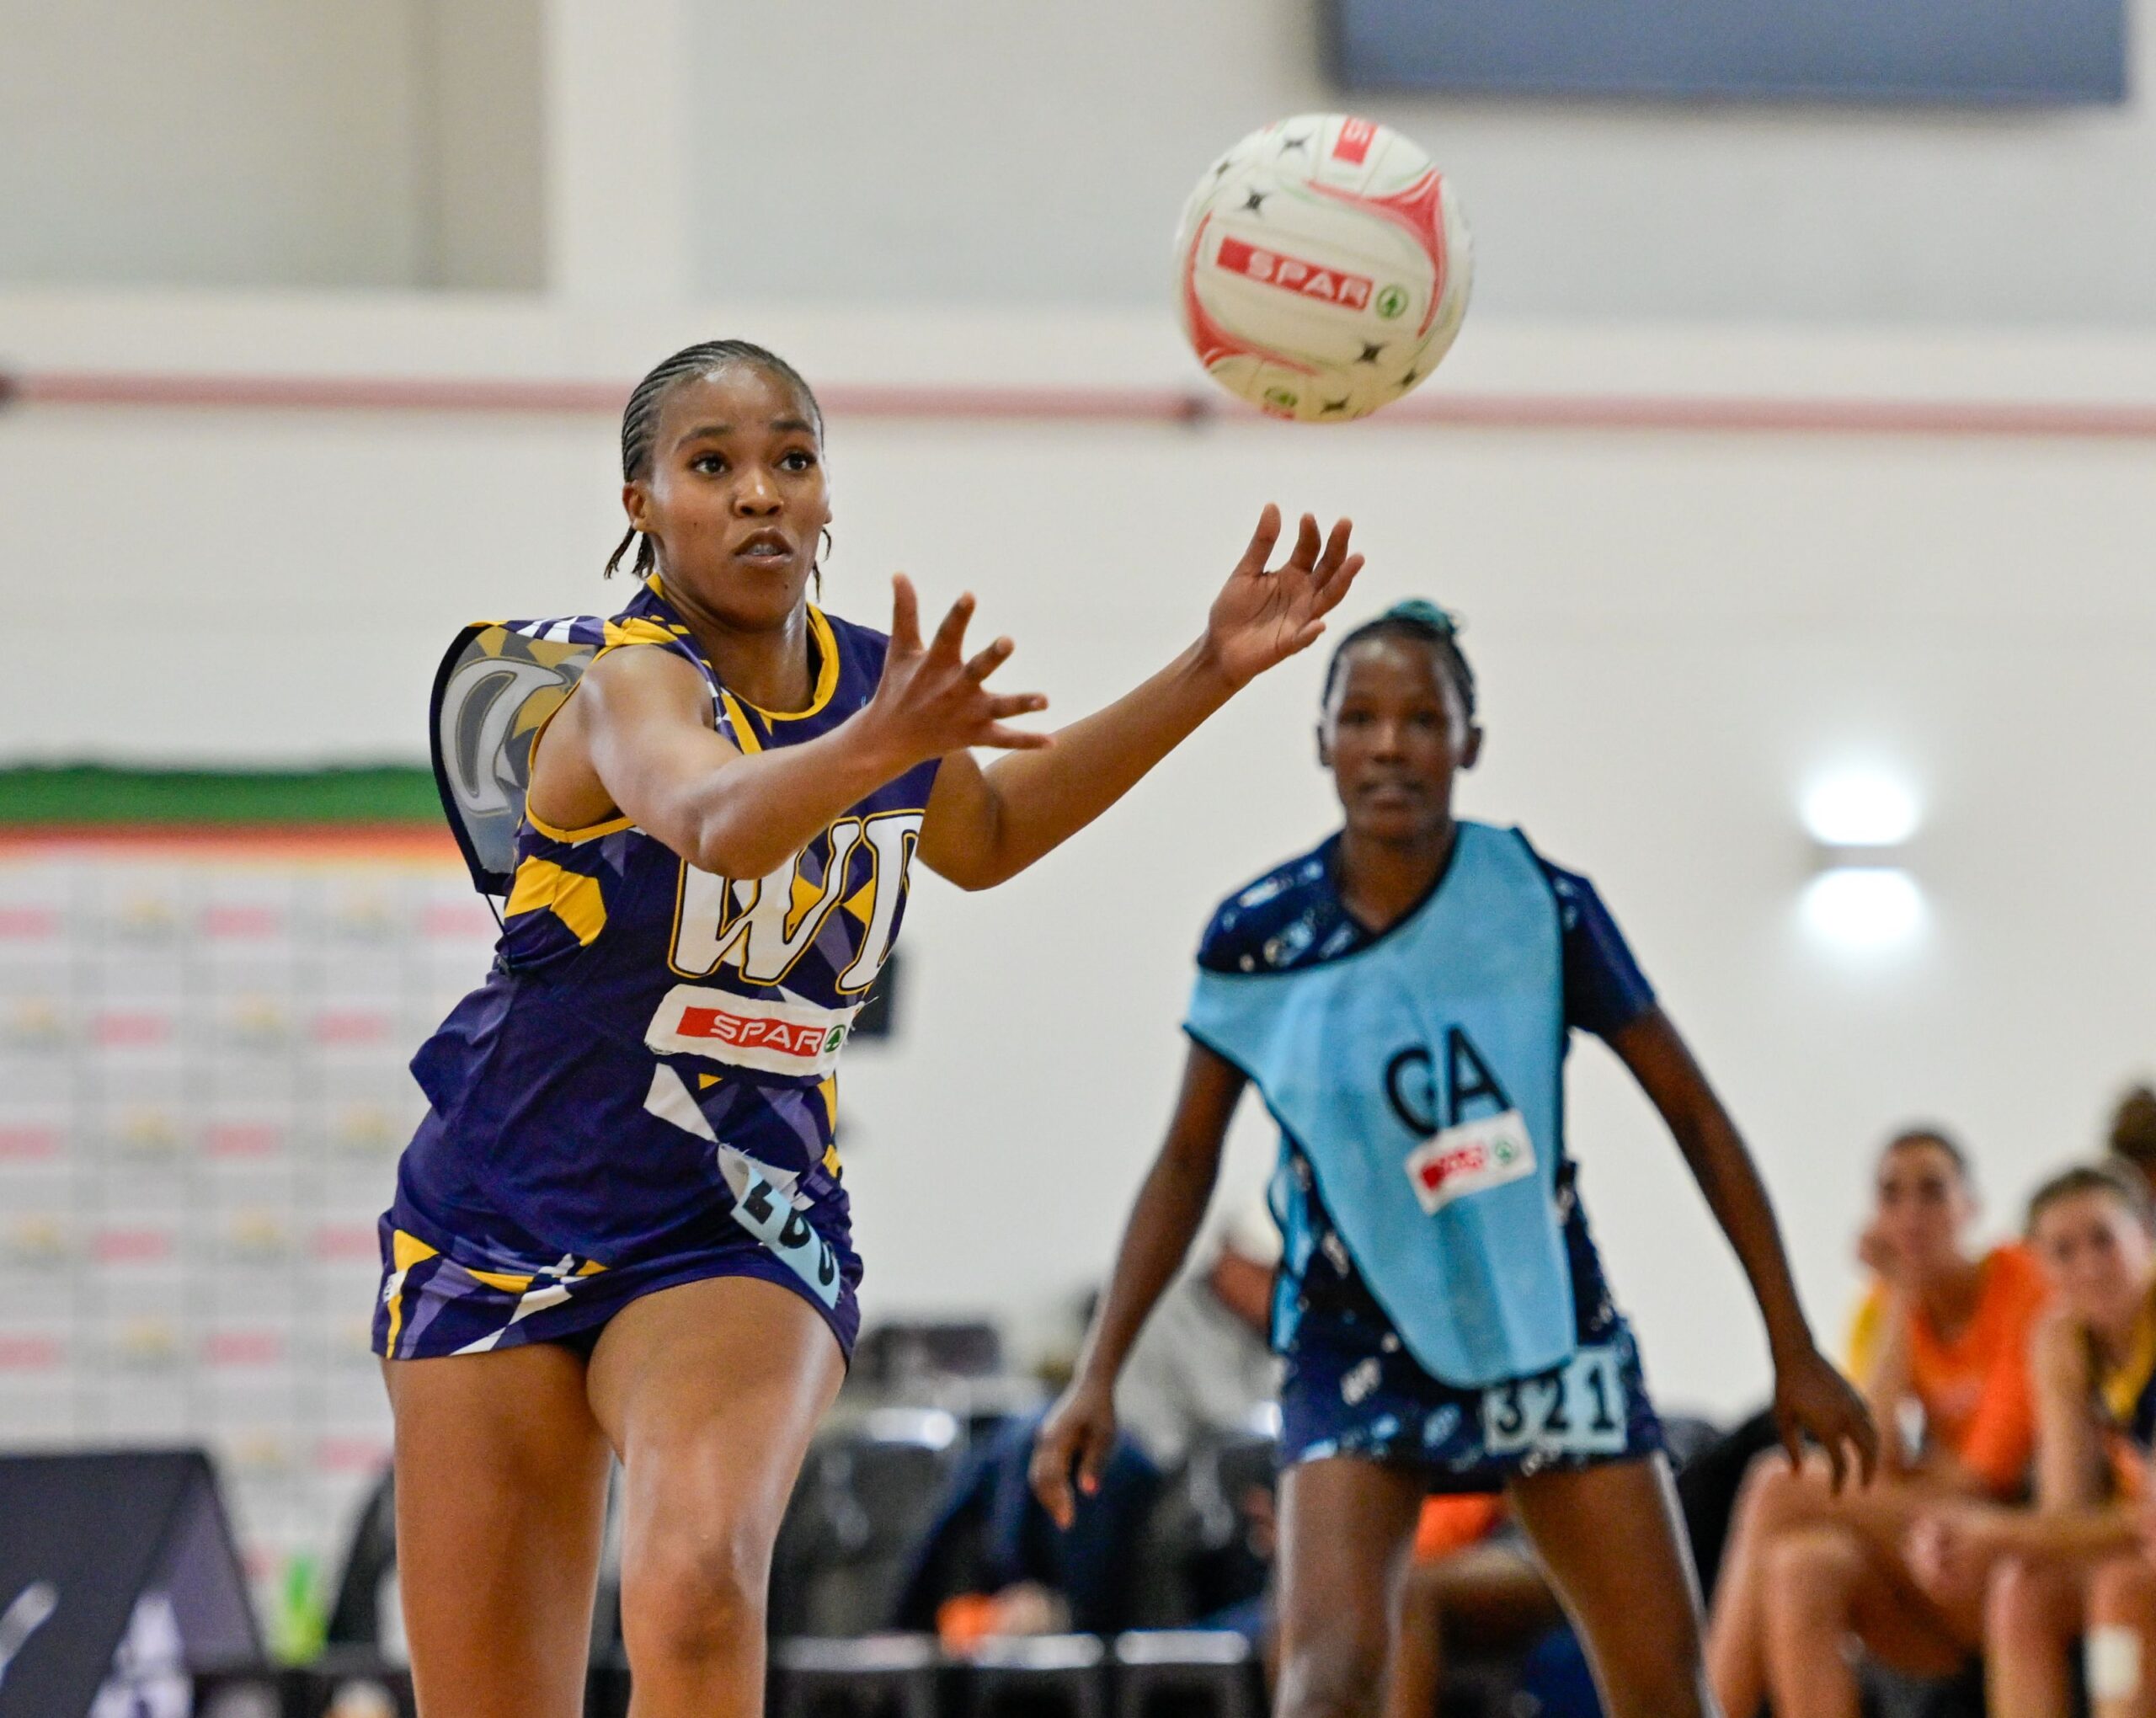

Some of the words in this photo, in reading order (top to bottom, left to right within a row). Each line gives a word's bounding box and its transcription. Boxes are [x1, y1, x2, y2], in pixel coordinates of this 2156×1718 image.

[1248, 252, 1367, 305] SPAR
[710, 1014, 822, 1053] SPAR
[1385, 1027, 1514, 1137] GA
[1496, 1364, 1616, 1434] 321
